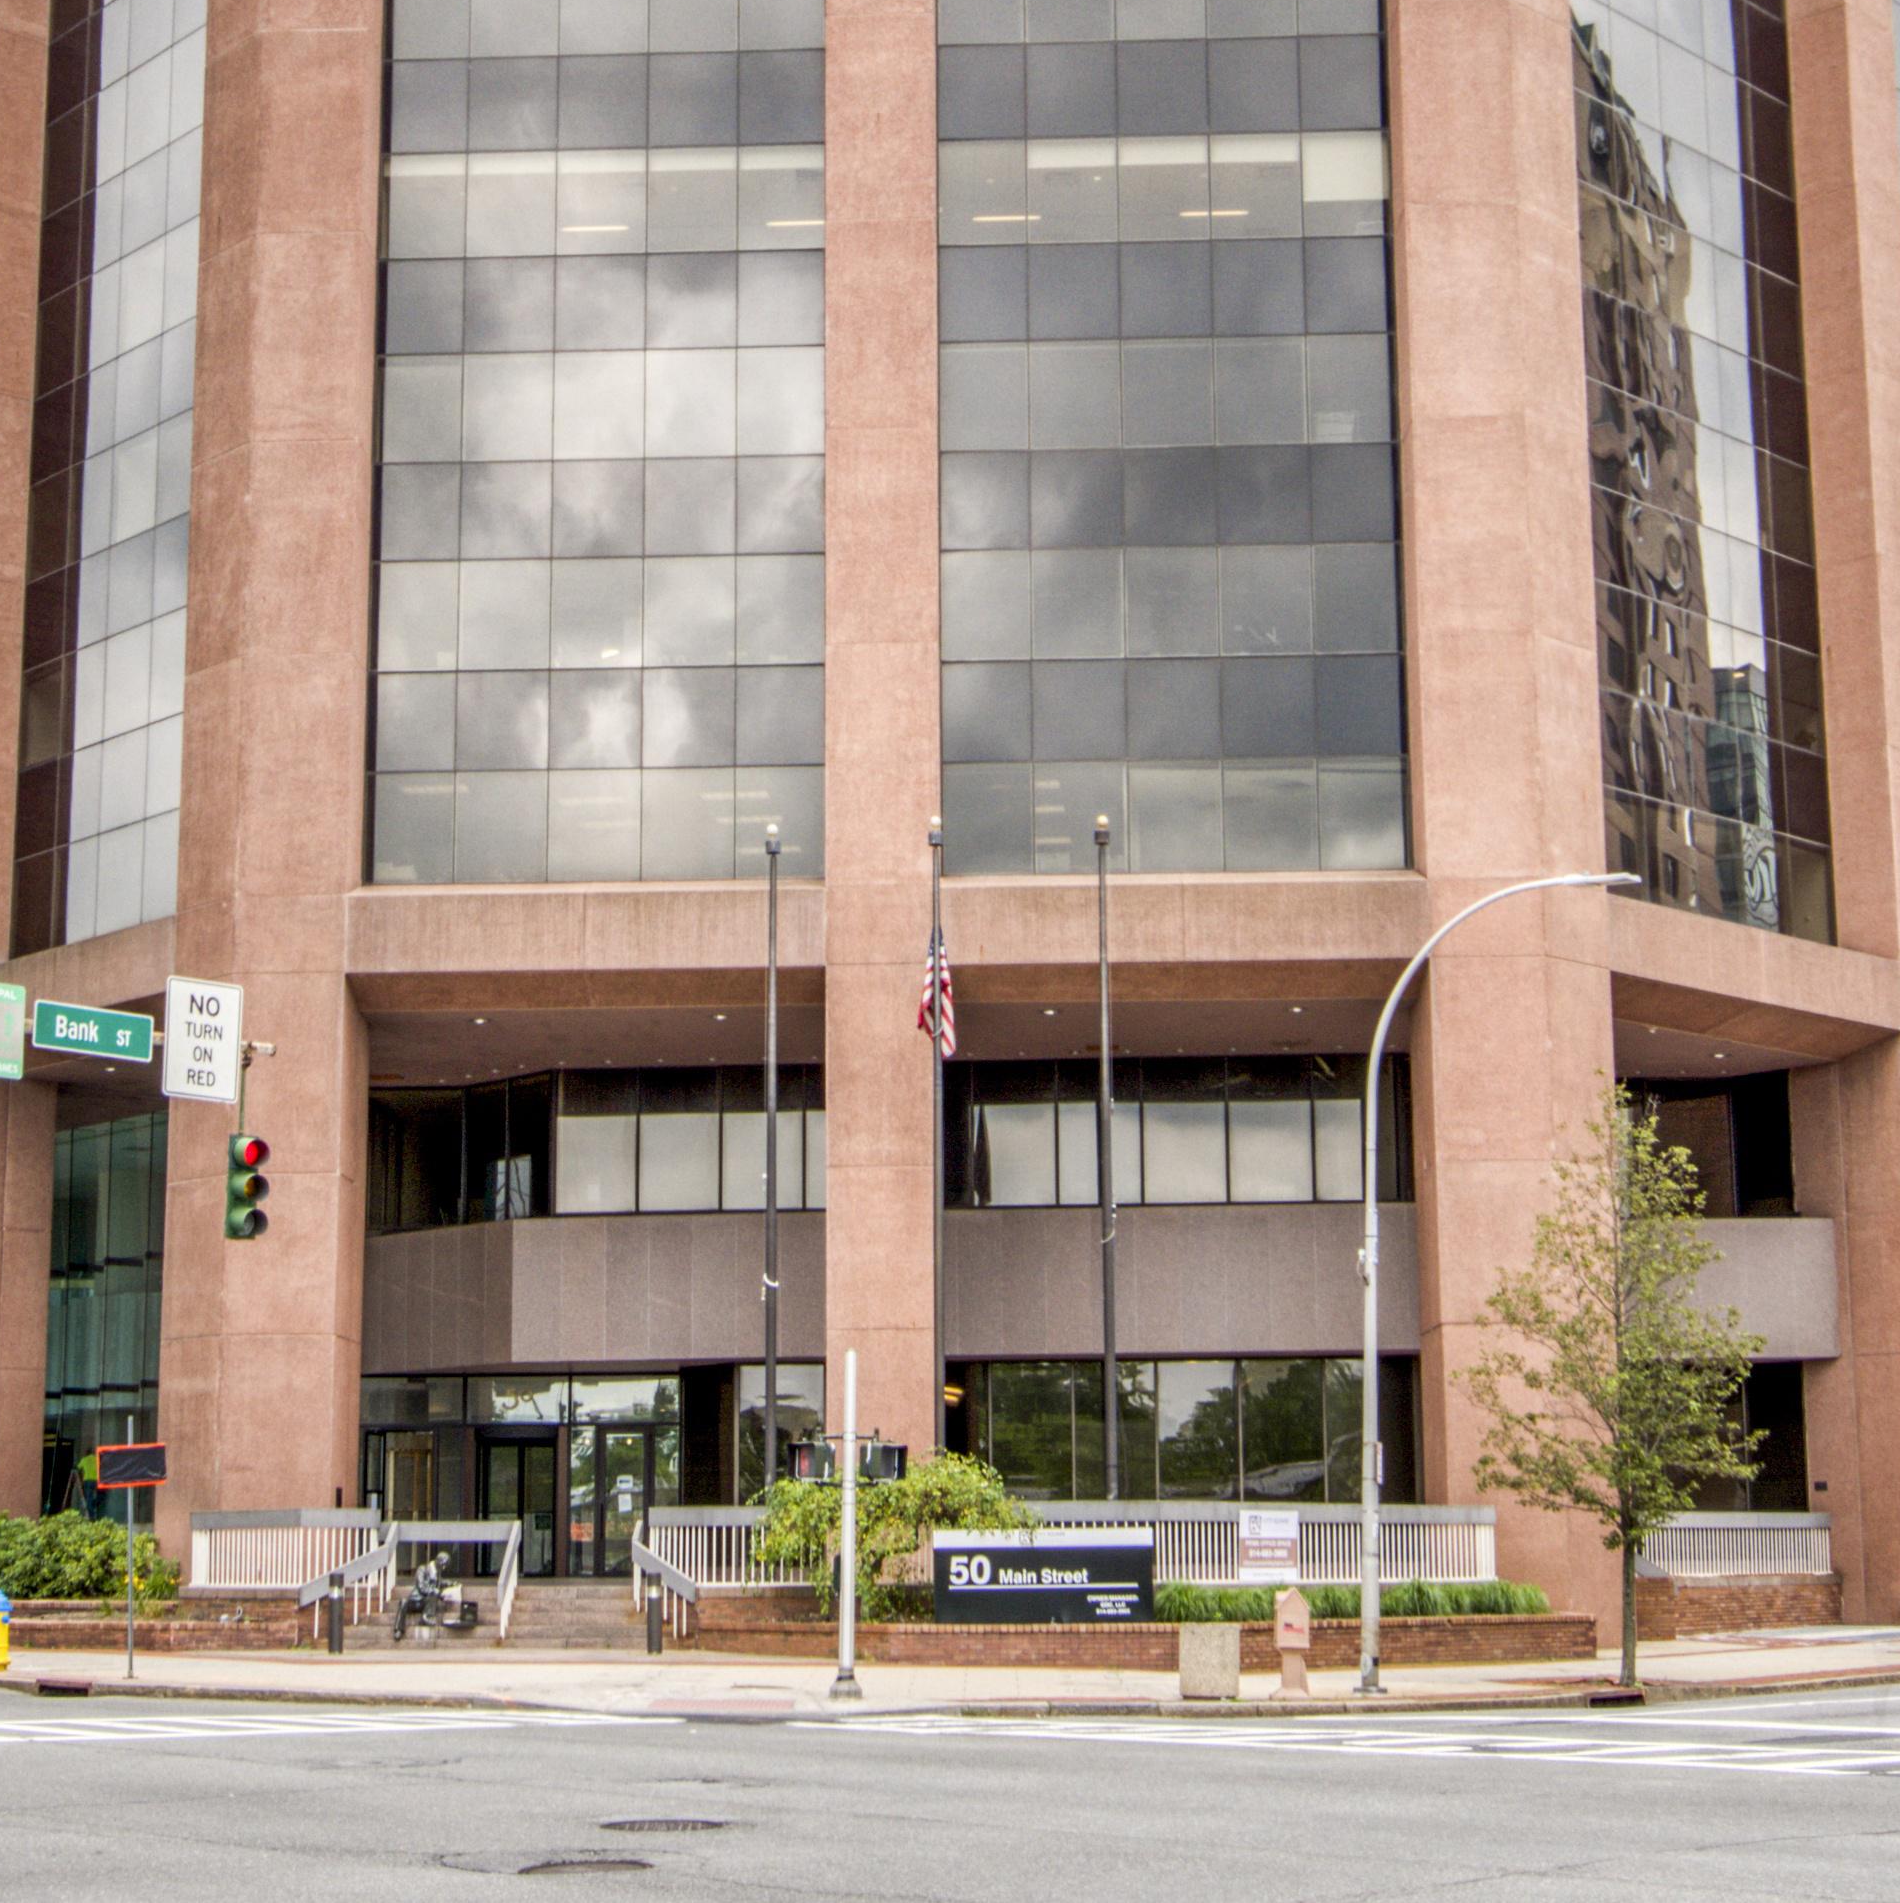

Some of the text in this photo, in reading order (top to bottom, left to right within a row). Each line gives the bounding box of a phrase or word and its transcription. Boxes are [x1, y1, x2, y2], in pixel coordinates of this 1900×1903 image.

[189, 994, 221, 1017] NO
[55, 1015, 132, 1047] Bank ST
[185, 1021, 223, 1041] TURN
[193, 1046, 213, 1063] ON
[186, 1069, 216, 1088] RED
[950, 1554, 1089, 1585] 50 Main Street
